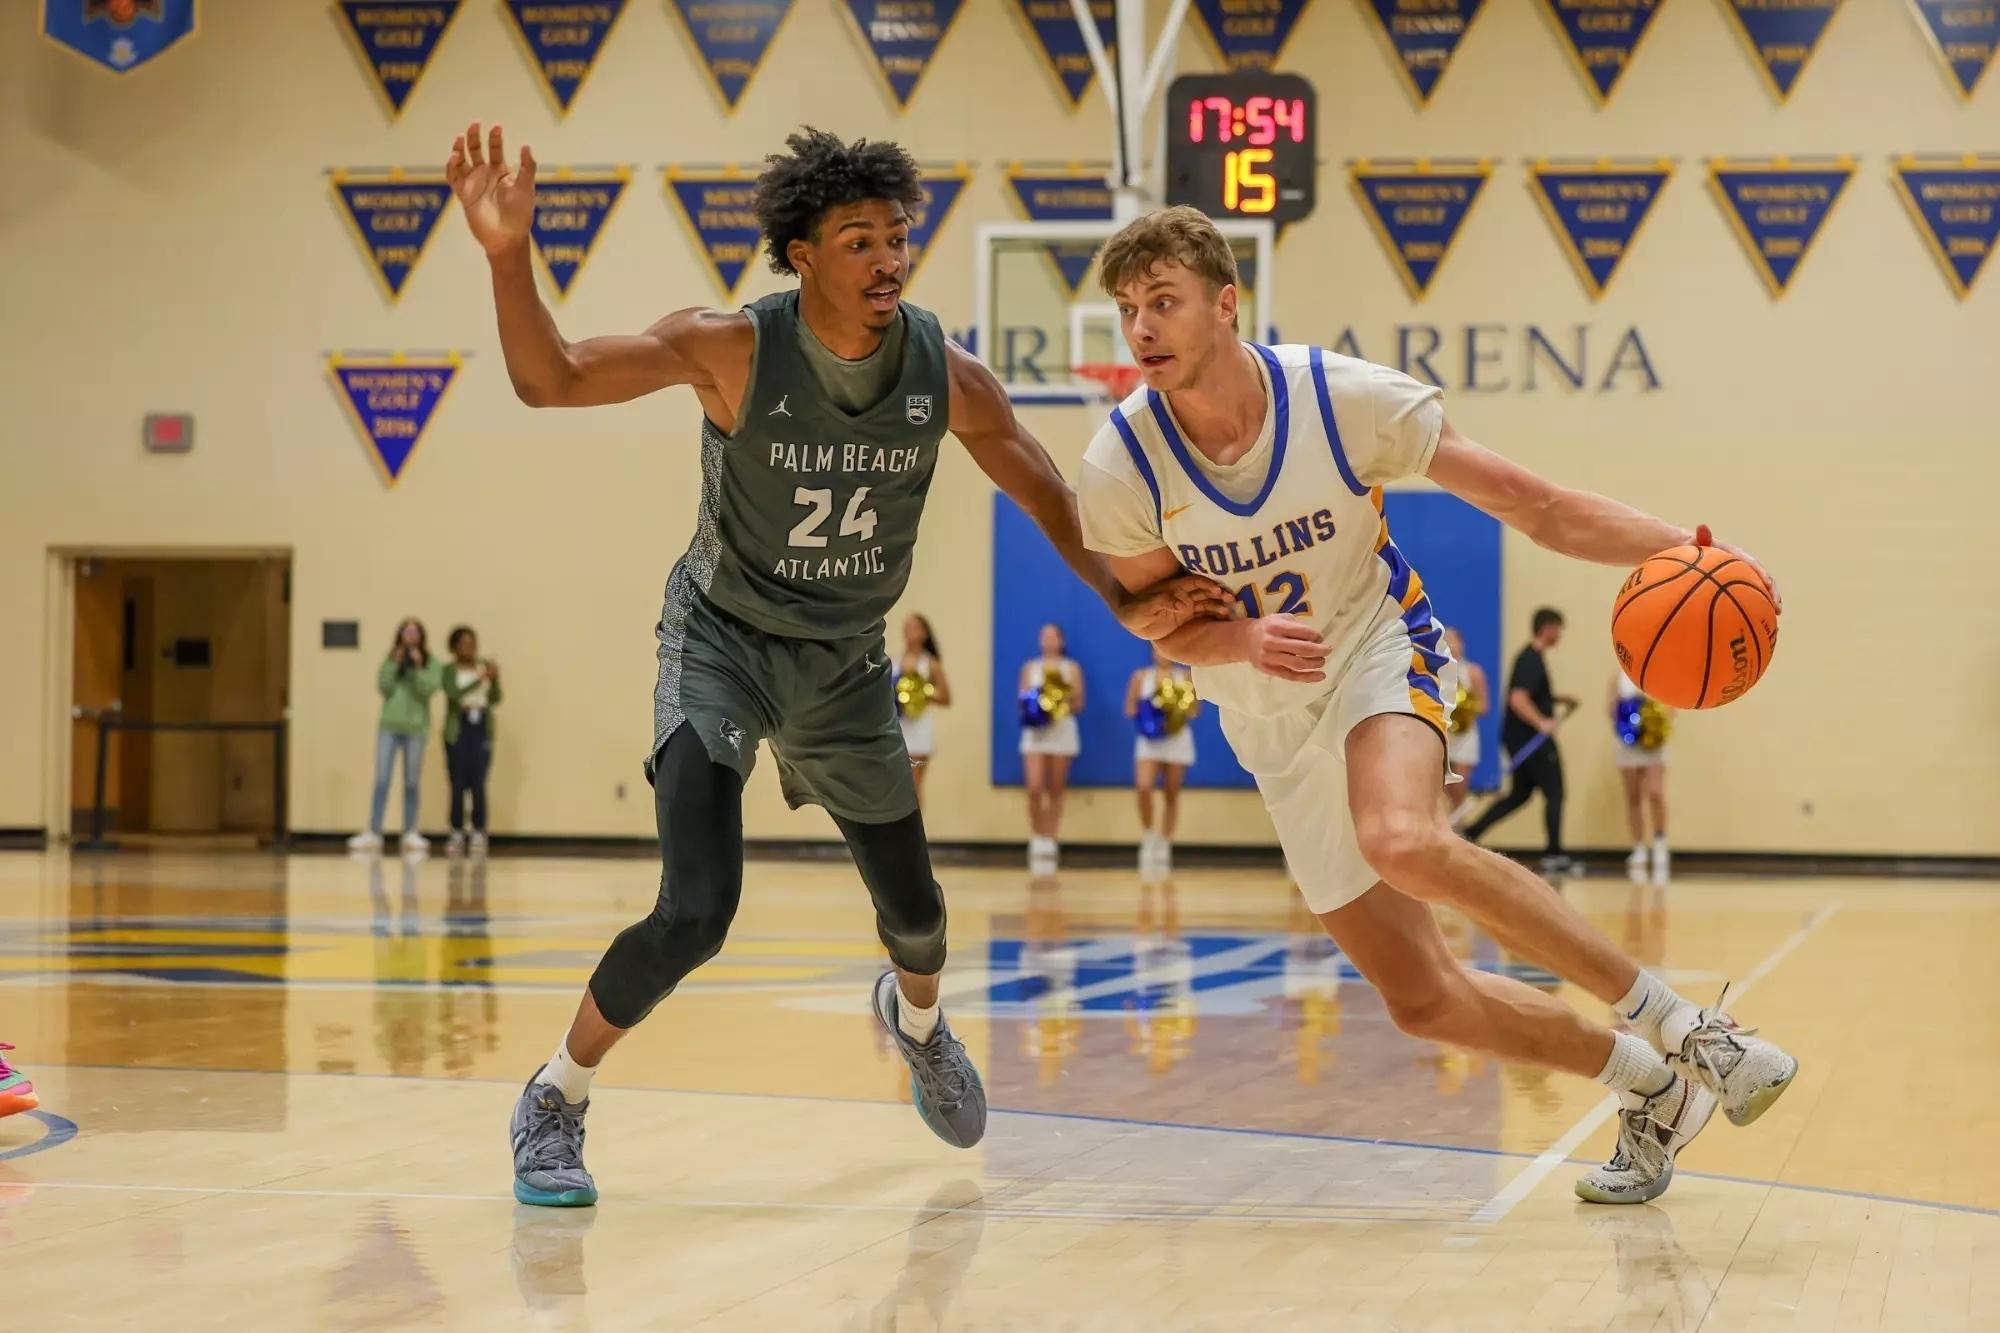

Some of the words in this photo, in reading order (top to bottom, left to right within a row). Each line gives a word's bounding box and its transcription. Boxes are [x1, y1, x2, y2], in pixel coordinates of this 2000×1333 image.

[1189, 97, 1304, 144] 17:54
[535, 191, 609, 208] OMEN'S
[1224, 149, 1276, 212] 15
[909, 397, 929, 405] SSC
[769, 442, 834, 473] PALM
[842, 443, 919, 473] BEACH
[787, 486, 878, 548] 24
[773, 546, 885, 581] ATLANTIC
[1178, 508, 1336, 576] ROLLINS
[1235, 570, 1313, 619] 12
[1718, 635, 1749, 703] ilson
